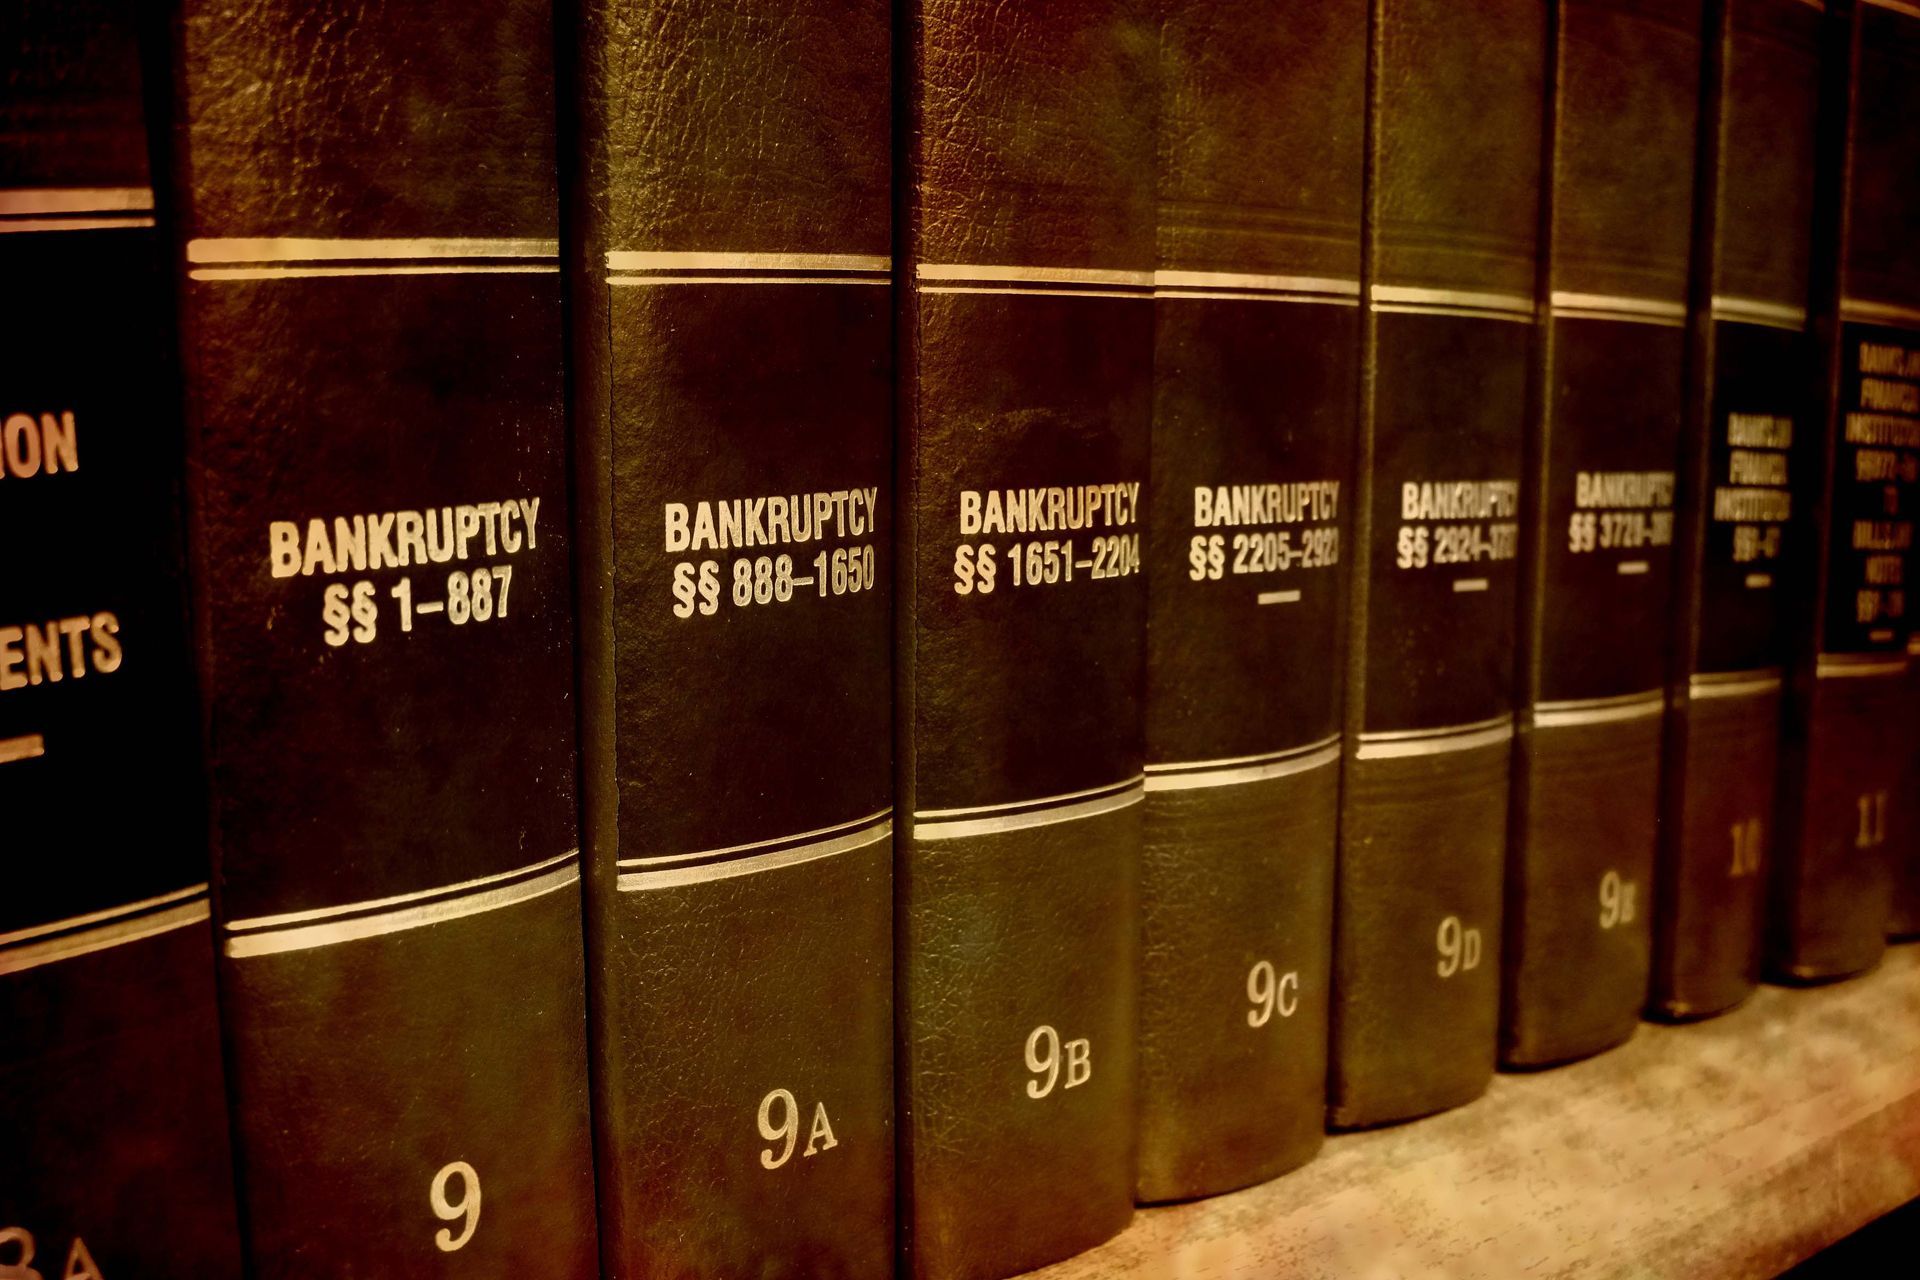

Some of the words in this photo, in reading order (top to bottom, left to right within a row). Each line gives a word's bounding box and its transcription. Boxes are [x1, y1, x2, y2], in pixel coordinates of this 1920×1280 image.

[665, 487, 878, 552] BANKRUPTCY
[960, 482, 1140, 535] BANKRUPTCY
[1194, 480, 1341, 527] BANKRUPTCY
[269, 497, 540, 578] BANKRUPTCY
[953, 543, 997, 595] §§
[1189, 535, 1225, 581] §§
[323, 580, 378, 646] §§
[672, 560, 721, 618] §§
[1437, 916, 1482, 978] 9D
[1247, 961, 1299, 1028] 9C
[1025, 1025, 1091, 1099] 9B
[757, 1087, 839, 1170] 9A
[430, 1160, 482, 1252] 9
